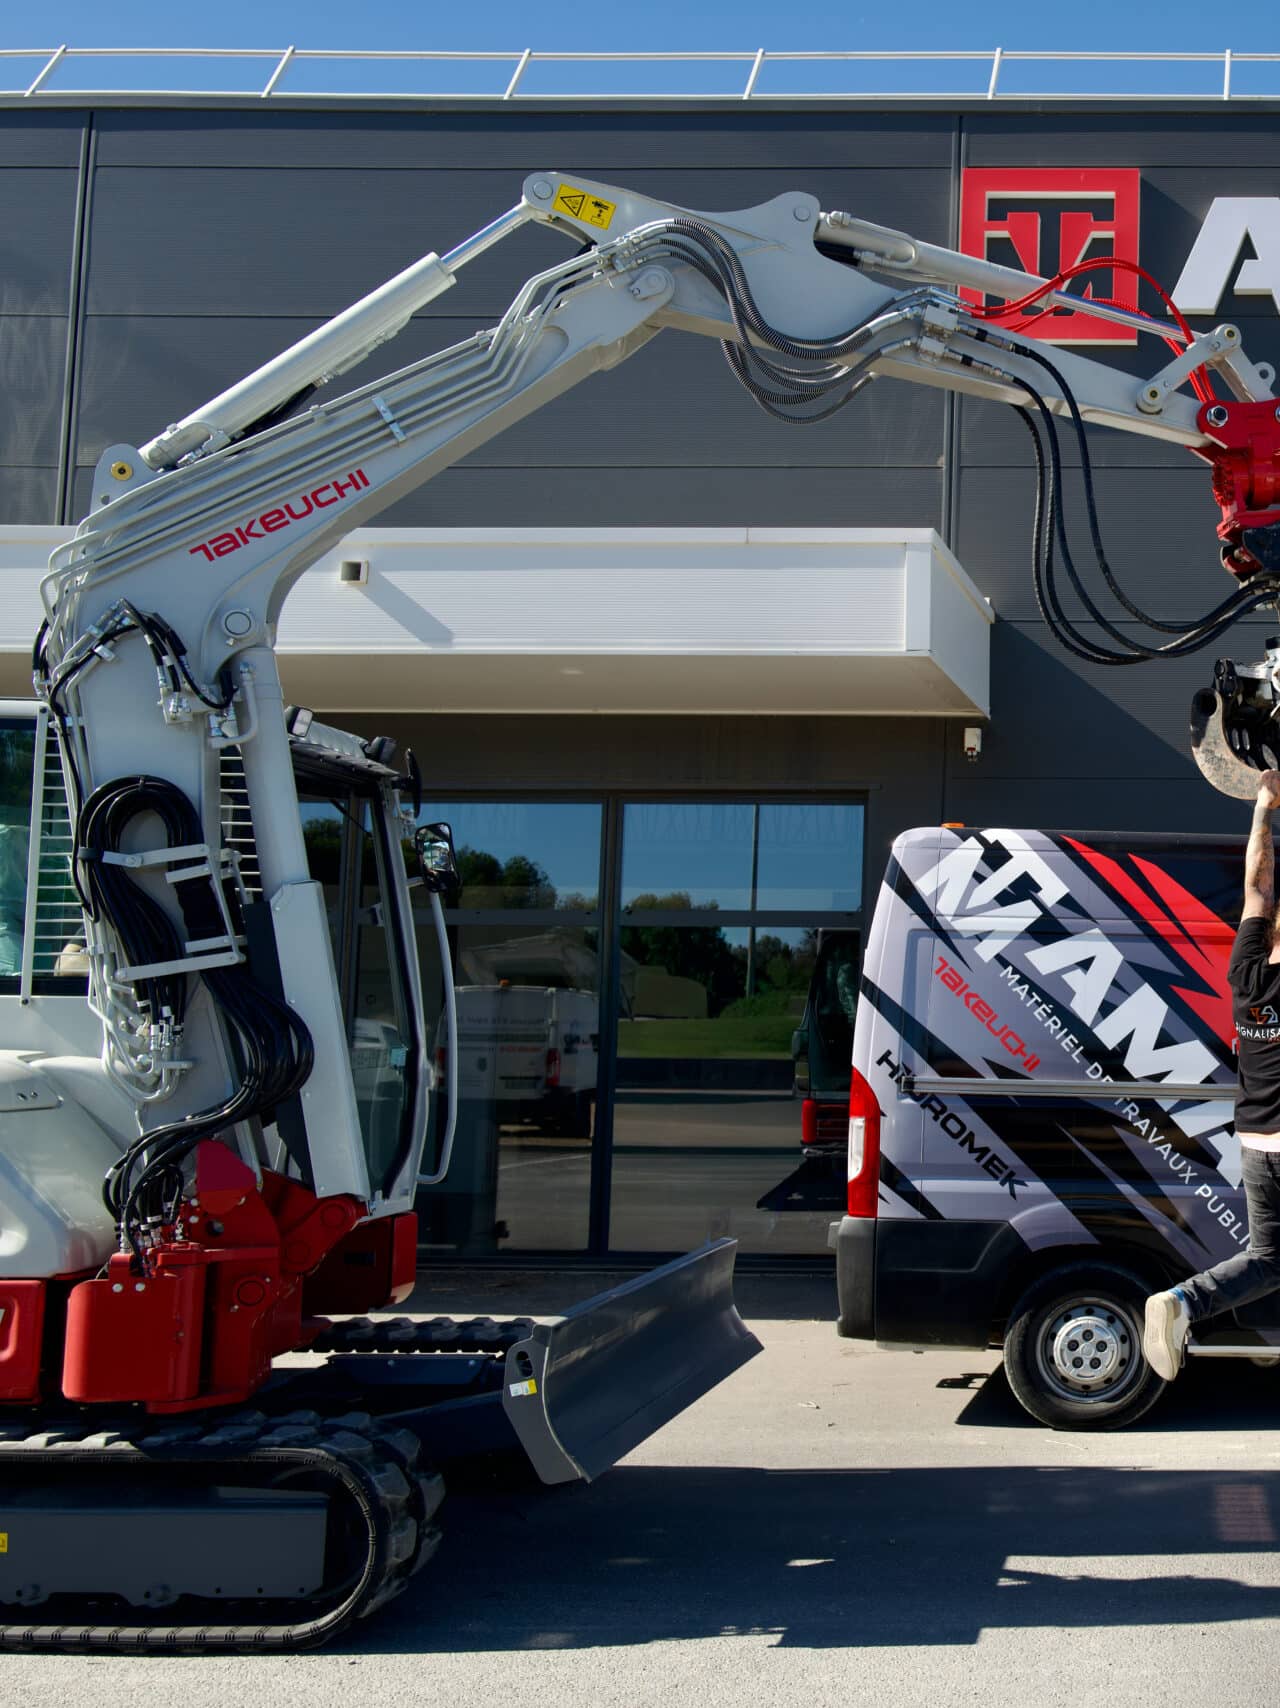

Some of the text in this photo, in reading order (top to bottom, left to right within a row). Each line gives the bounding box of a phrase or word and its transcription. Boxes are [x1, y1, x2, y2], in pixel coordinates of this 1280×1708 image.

[188, 468, 370, 562] TAKEUCHI
[934, 956, 1041, 1073] TAKEUCHI
[999, 965, 1081, 1063] MATÉRIEL
[1194, 1183, 1251, 1251] PUBLI
[1023, 927, 1243, 1191] AMA
